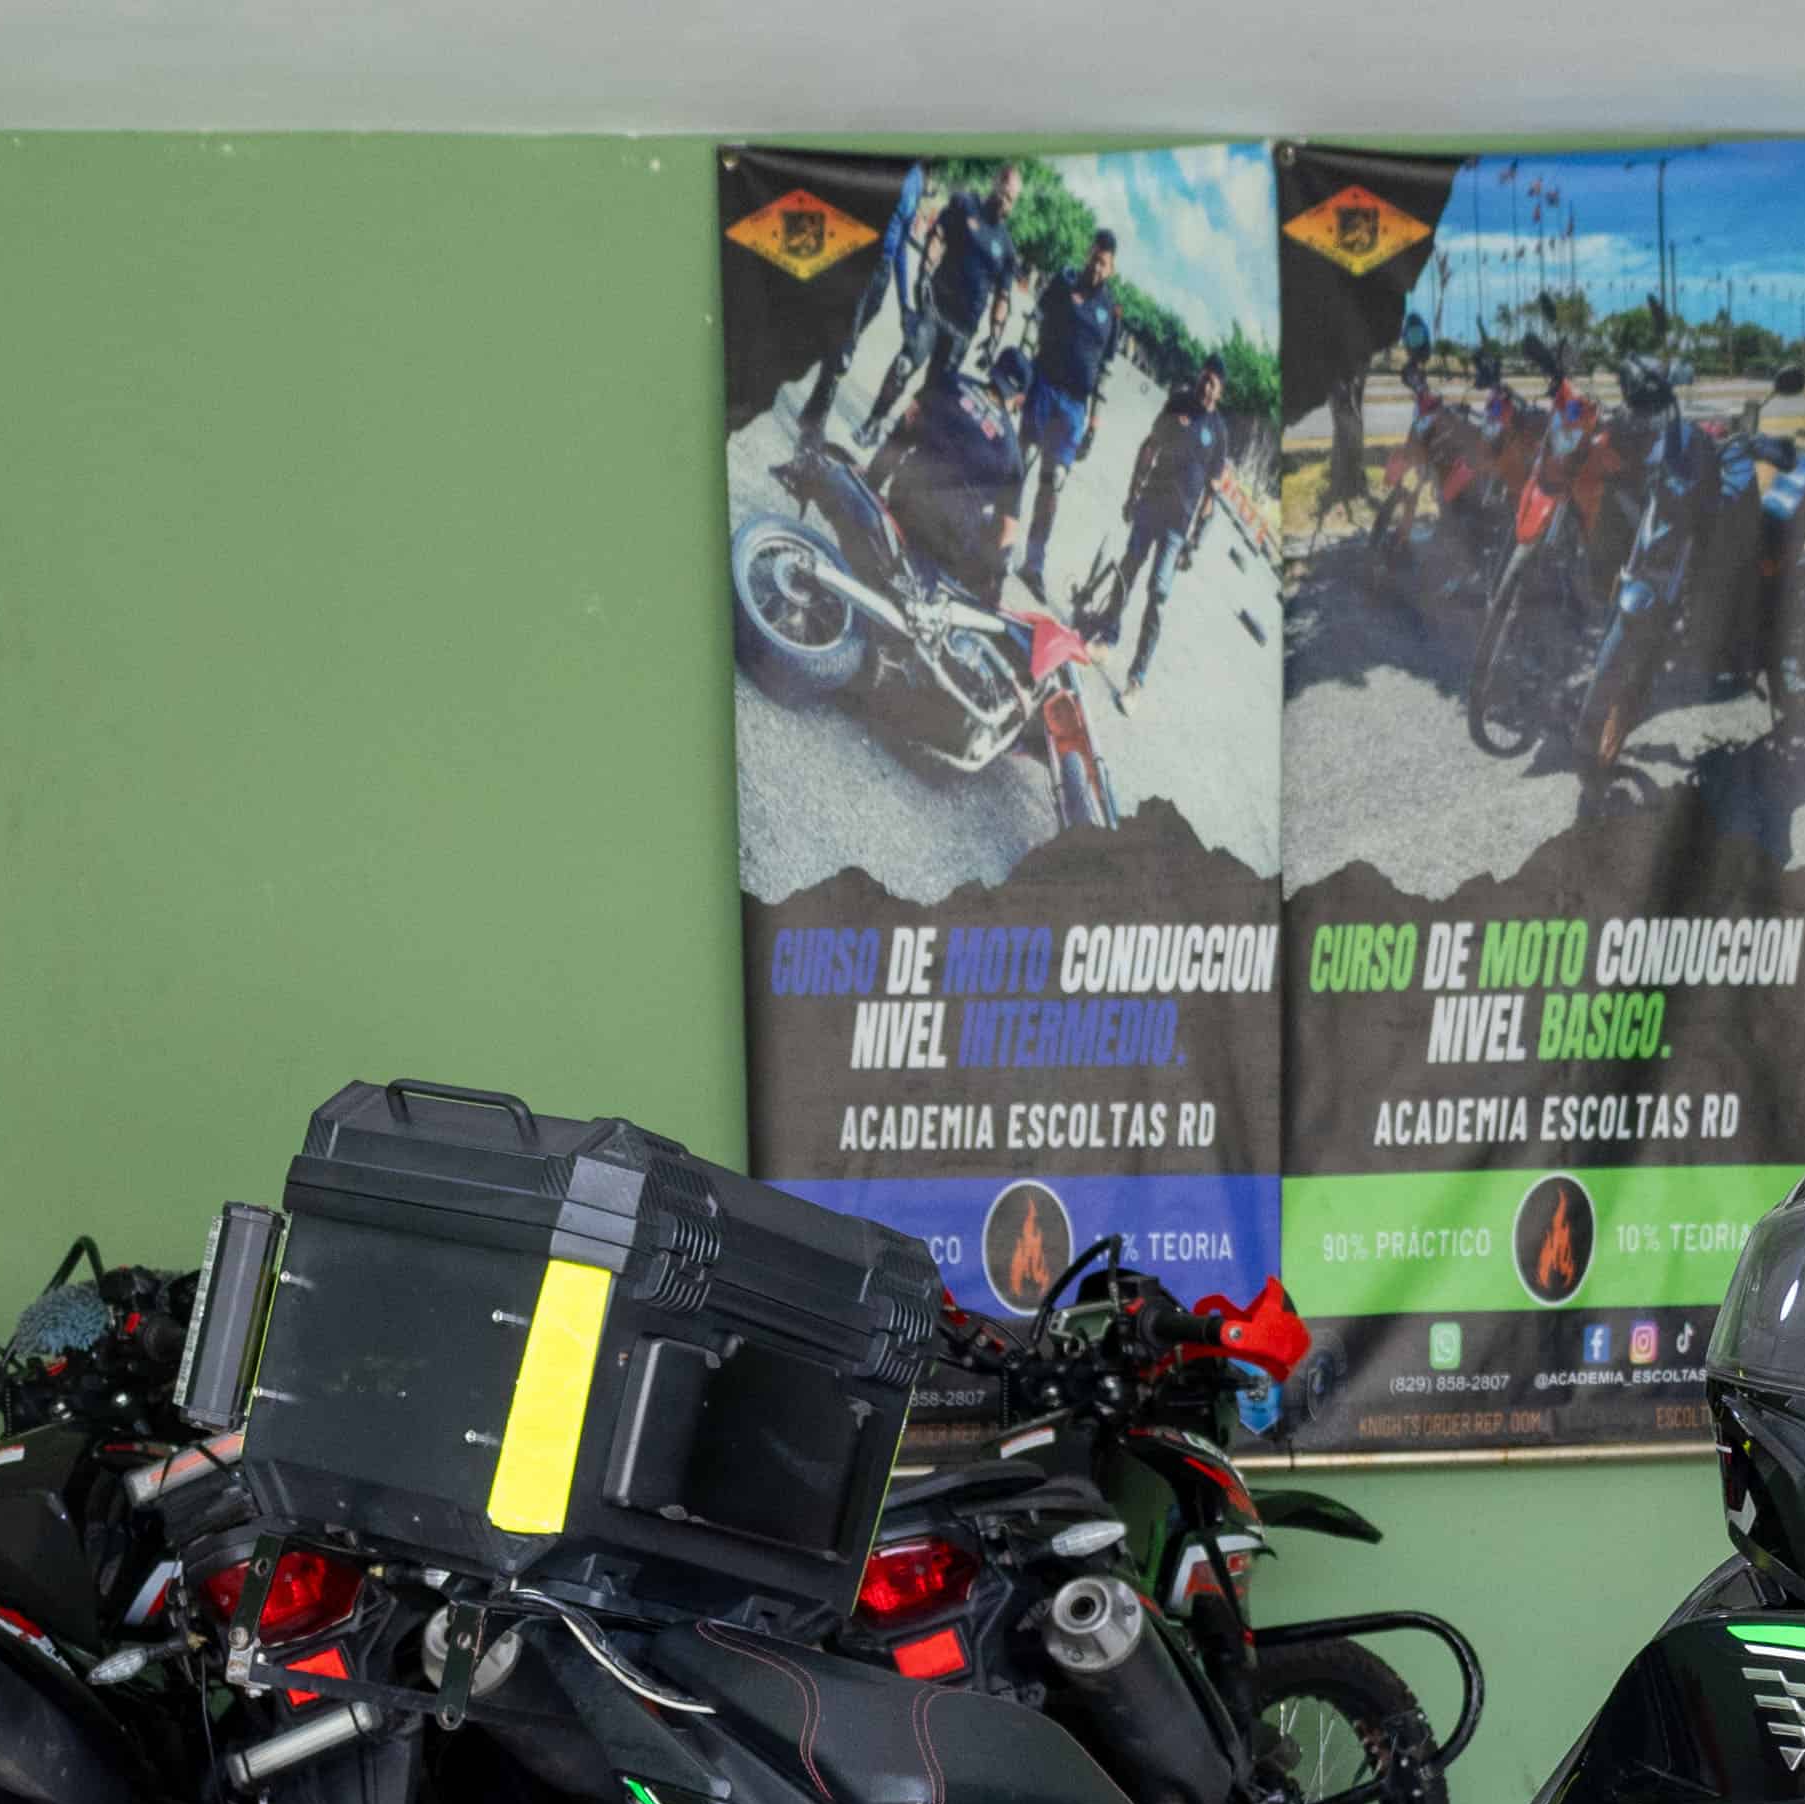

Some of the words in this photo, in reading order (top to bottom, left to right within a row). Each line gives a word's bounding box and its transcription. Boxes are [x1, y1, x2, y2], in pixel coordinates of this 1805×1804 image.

[770, 928, 881, 996] CURSO
[886, 927, 937, 995] DE
[942, 926, 1053, 995] MOTO
[1060, 924, 1280, 993] CONDUCCION
[1309, 923, 1418, 993] CURSO
[1422, 921, 1474, 990] DE
[1477, 919, 1589, 990] MOTO
[1595, 916, 1805, 987] CONDUCCION
[850, 1001, 948, 1069] NIVEL
[957, 999, 1188, 1068] INTERMEDIO.
[1427, 996, 1527, 1064] NIVEL
[1537, 991, 1673, 1060] BASICO.
[839, 1104, 995, 1151] ACADEMIA
[1006, 1103, 1167, 1150] ESCOLTAS
[1177, 1102, 1216, 1147] RD
[1373, 1097, 1527, 1147] ACADEMIA
[1540, 1095, 1691, 1142] ESCOLTAS
[1700, 1094, 1741, 1139] RD
[1148, 1232, 1234, 1261] TEORIA
[1322, 1232, 1368, 1262] 90%
[1615, 1223, 1660, 1253] 10%
[1669, 1221, 1752, 1251] TEORIA
[1389, 1375, 1433, 1394] (829)
[1436, 1373, 1511, 1392] 858-2807
